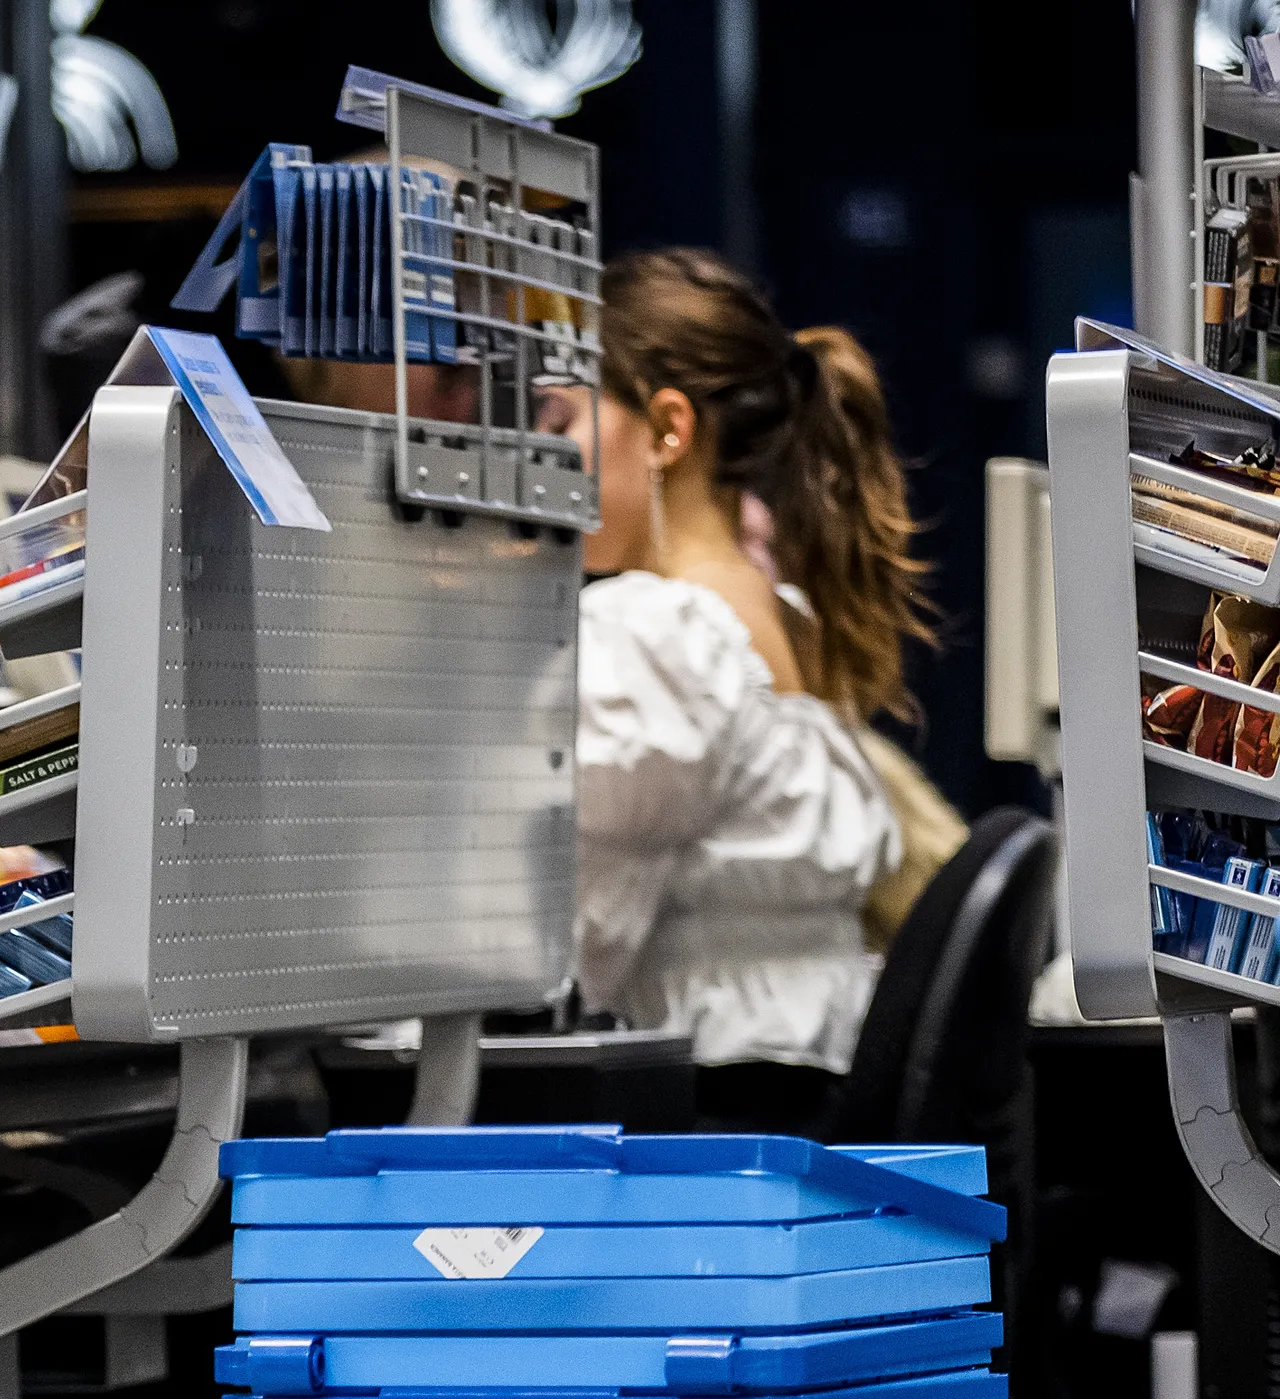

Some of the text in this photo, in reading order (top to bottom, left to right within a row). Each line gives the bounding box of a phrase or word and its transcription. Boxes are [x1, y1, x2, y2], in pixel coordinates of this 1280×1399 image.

[8, 755, 78, 787] SALT & PEPP
